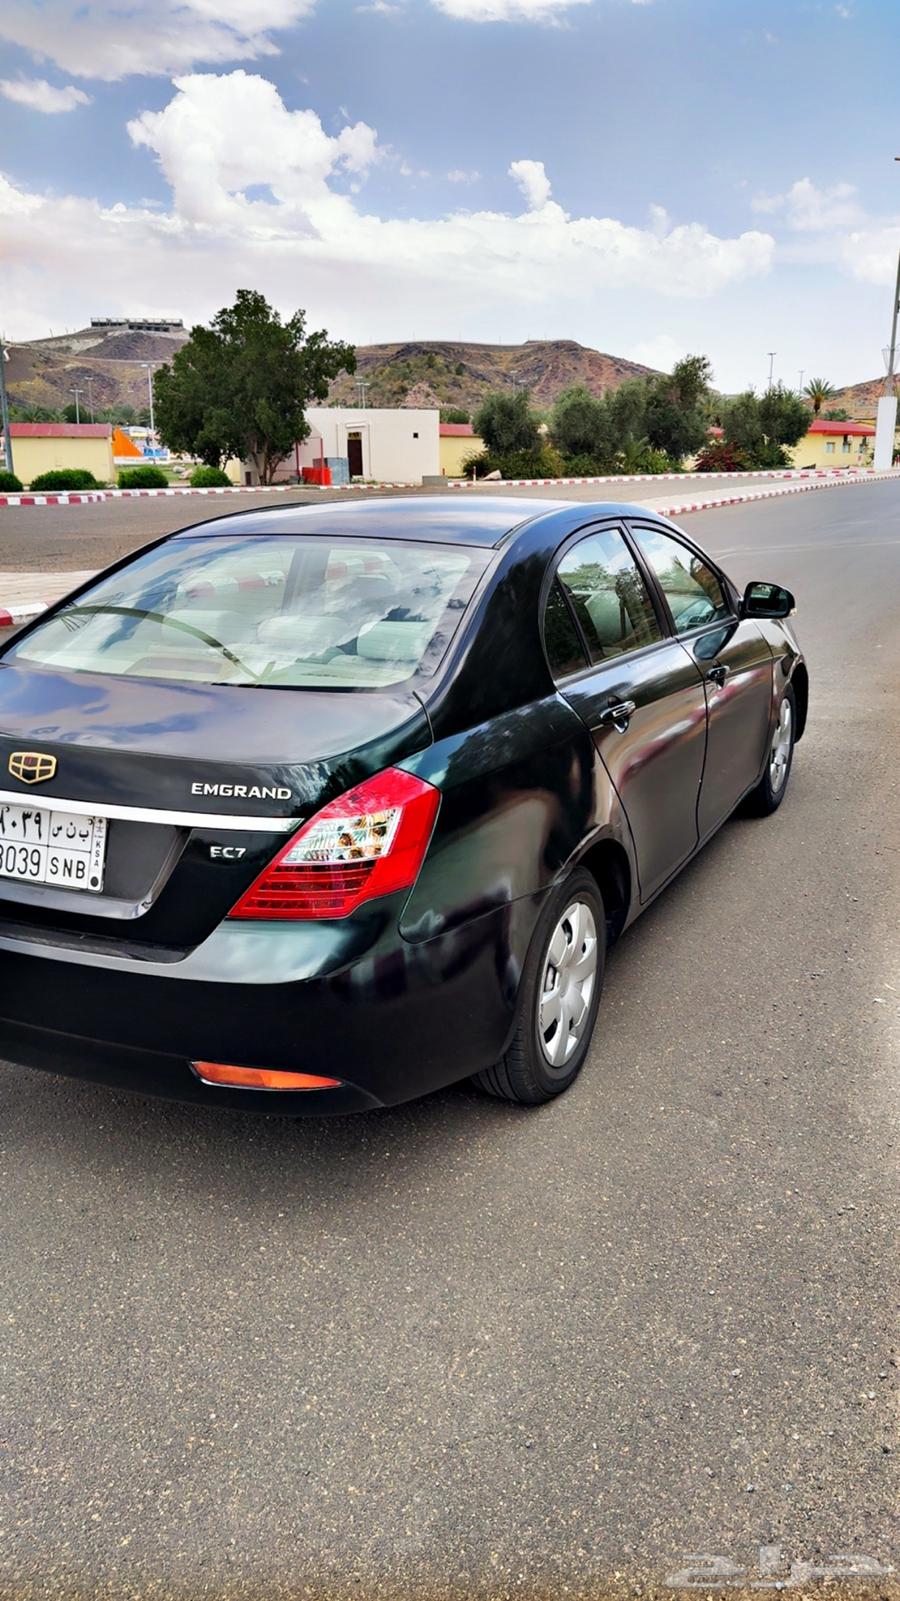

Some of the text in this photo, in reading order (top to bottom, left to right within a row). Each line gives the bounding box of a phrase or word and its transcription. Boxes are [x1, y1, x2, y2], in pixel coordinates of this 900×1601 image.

[191, 782, 292, 800] EMGRAND
[210, 845, 246, 859] EC7
[50, 857, 86, 879] SNB
